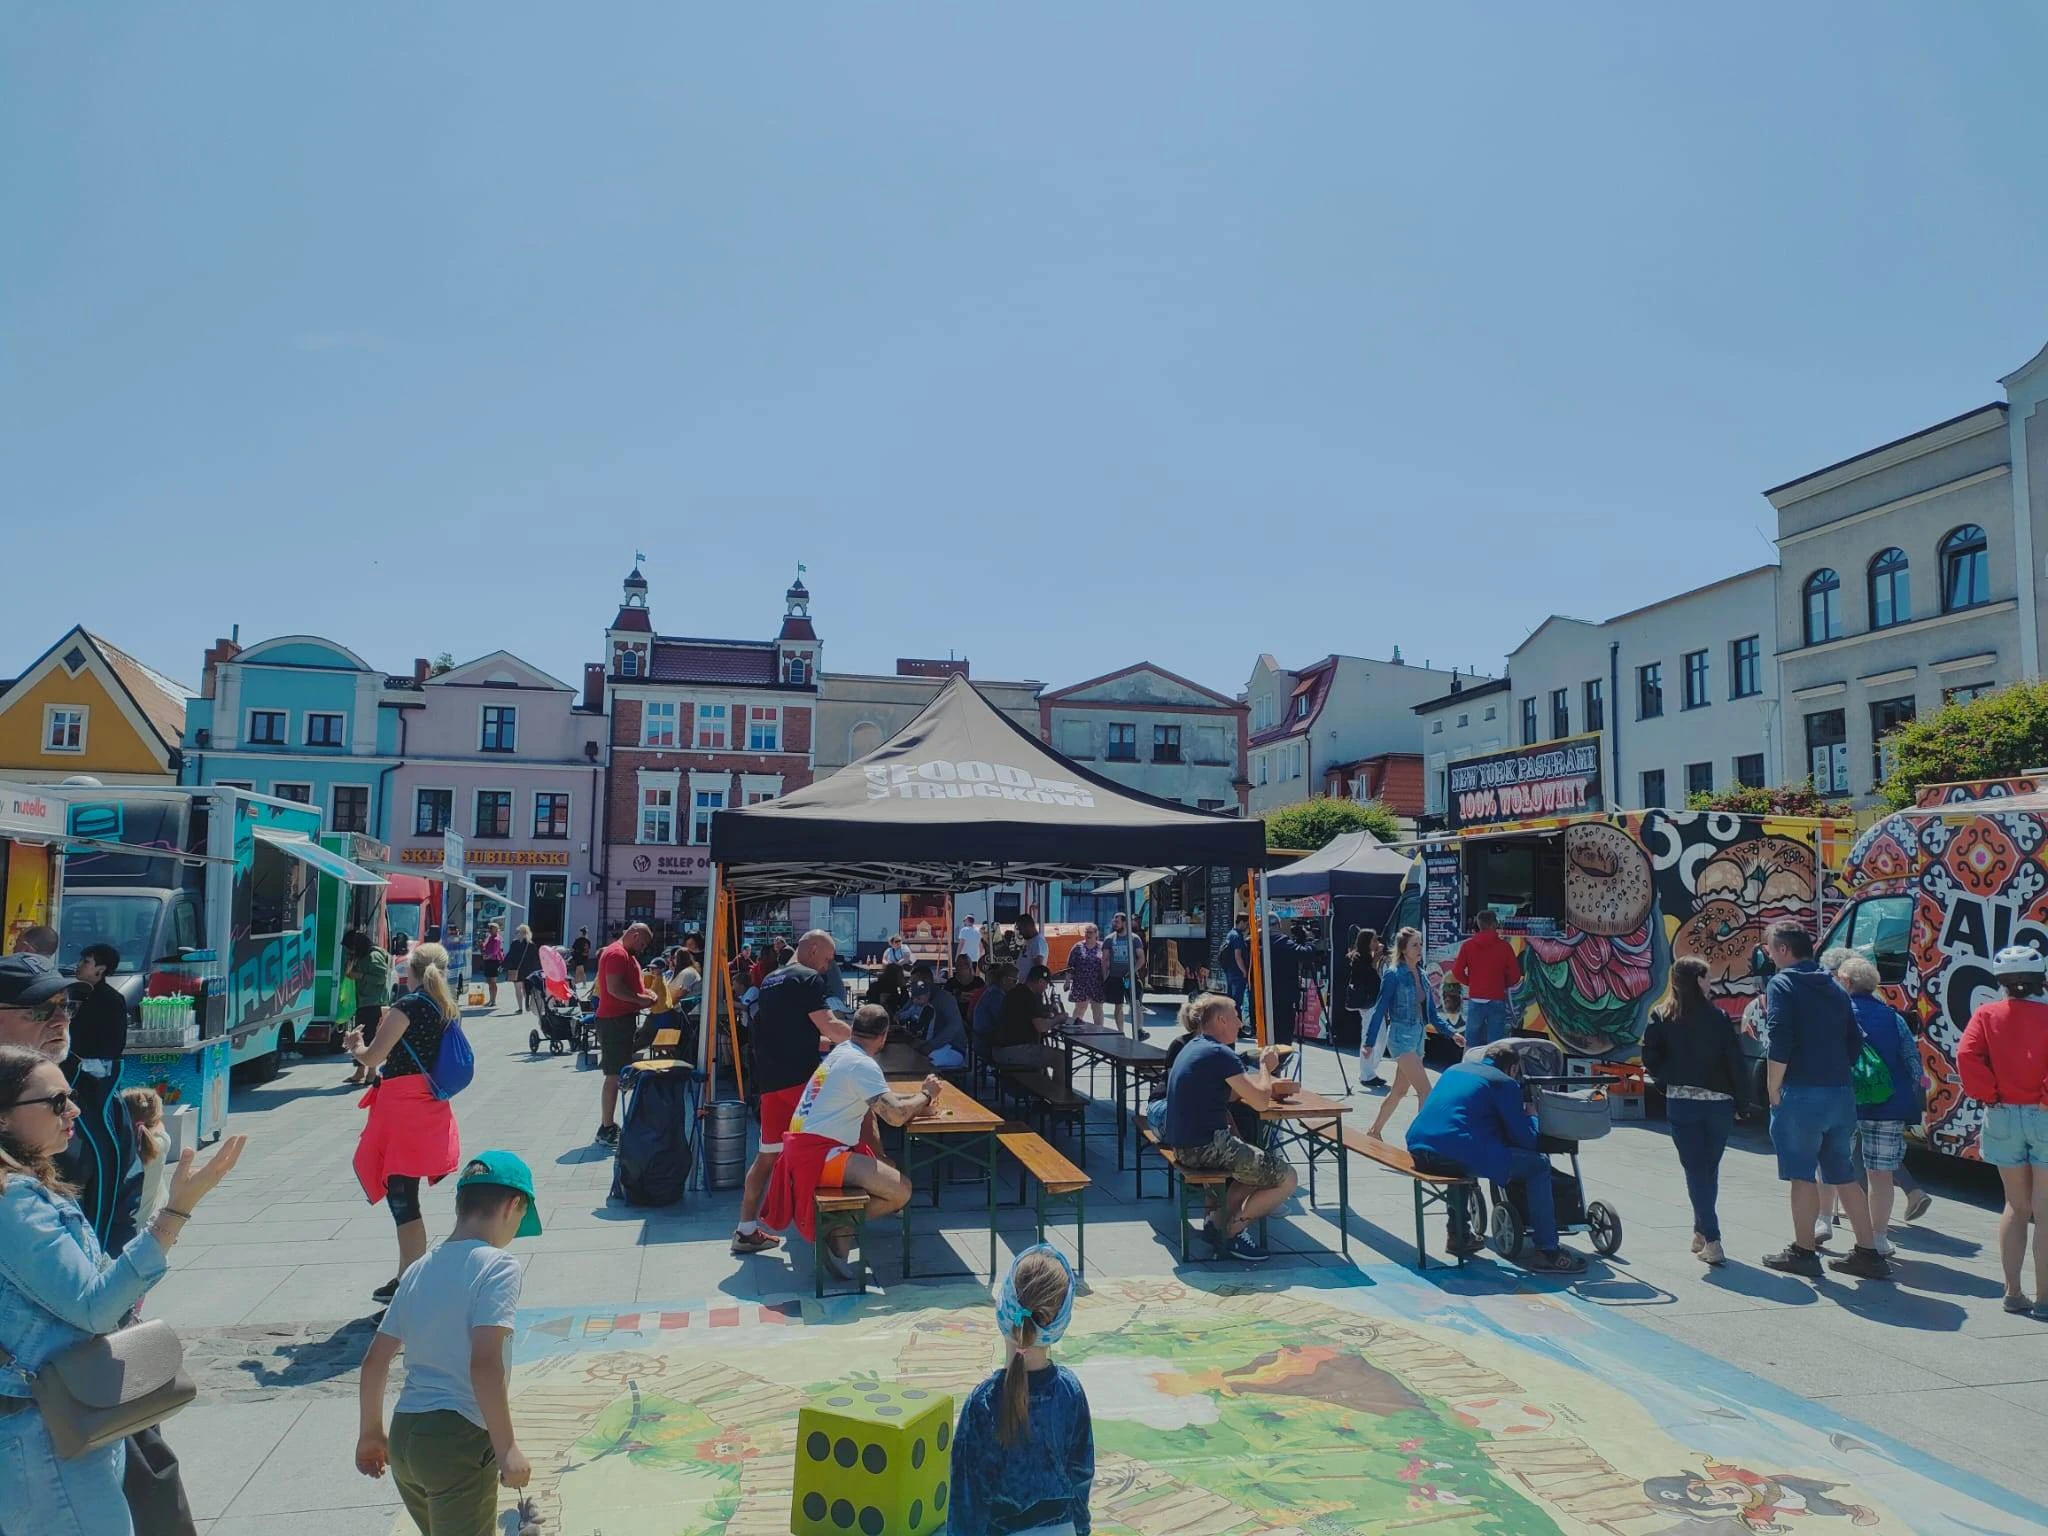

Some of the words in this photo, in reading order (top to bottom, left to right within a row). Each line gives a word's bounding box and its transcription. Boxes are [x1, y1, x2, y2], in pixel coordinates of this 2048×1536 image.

[890, 760, 1034, 787] FOOD
[1451, 766, 1479, 792] NEW
[1478, 759, 1517, 787] YORK
[1517, 746, 1597, 782] PASTRAMI
[13, 797, 47, 818] nutella
[1459, 789, 1498, 820] 100%
[400, 849, 445, 864] SKLE
[465, 850, 569, 866] JUBILERSKI
[657, 856, 694, 868] SKLEP
